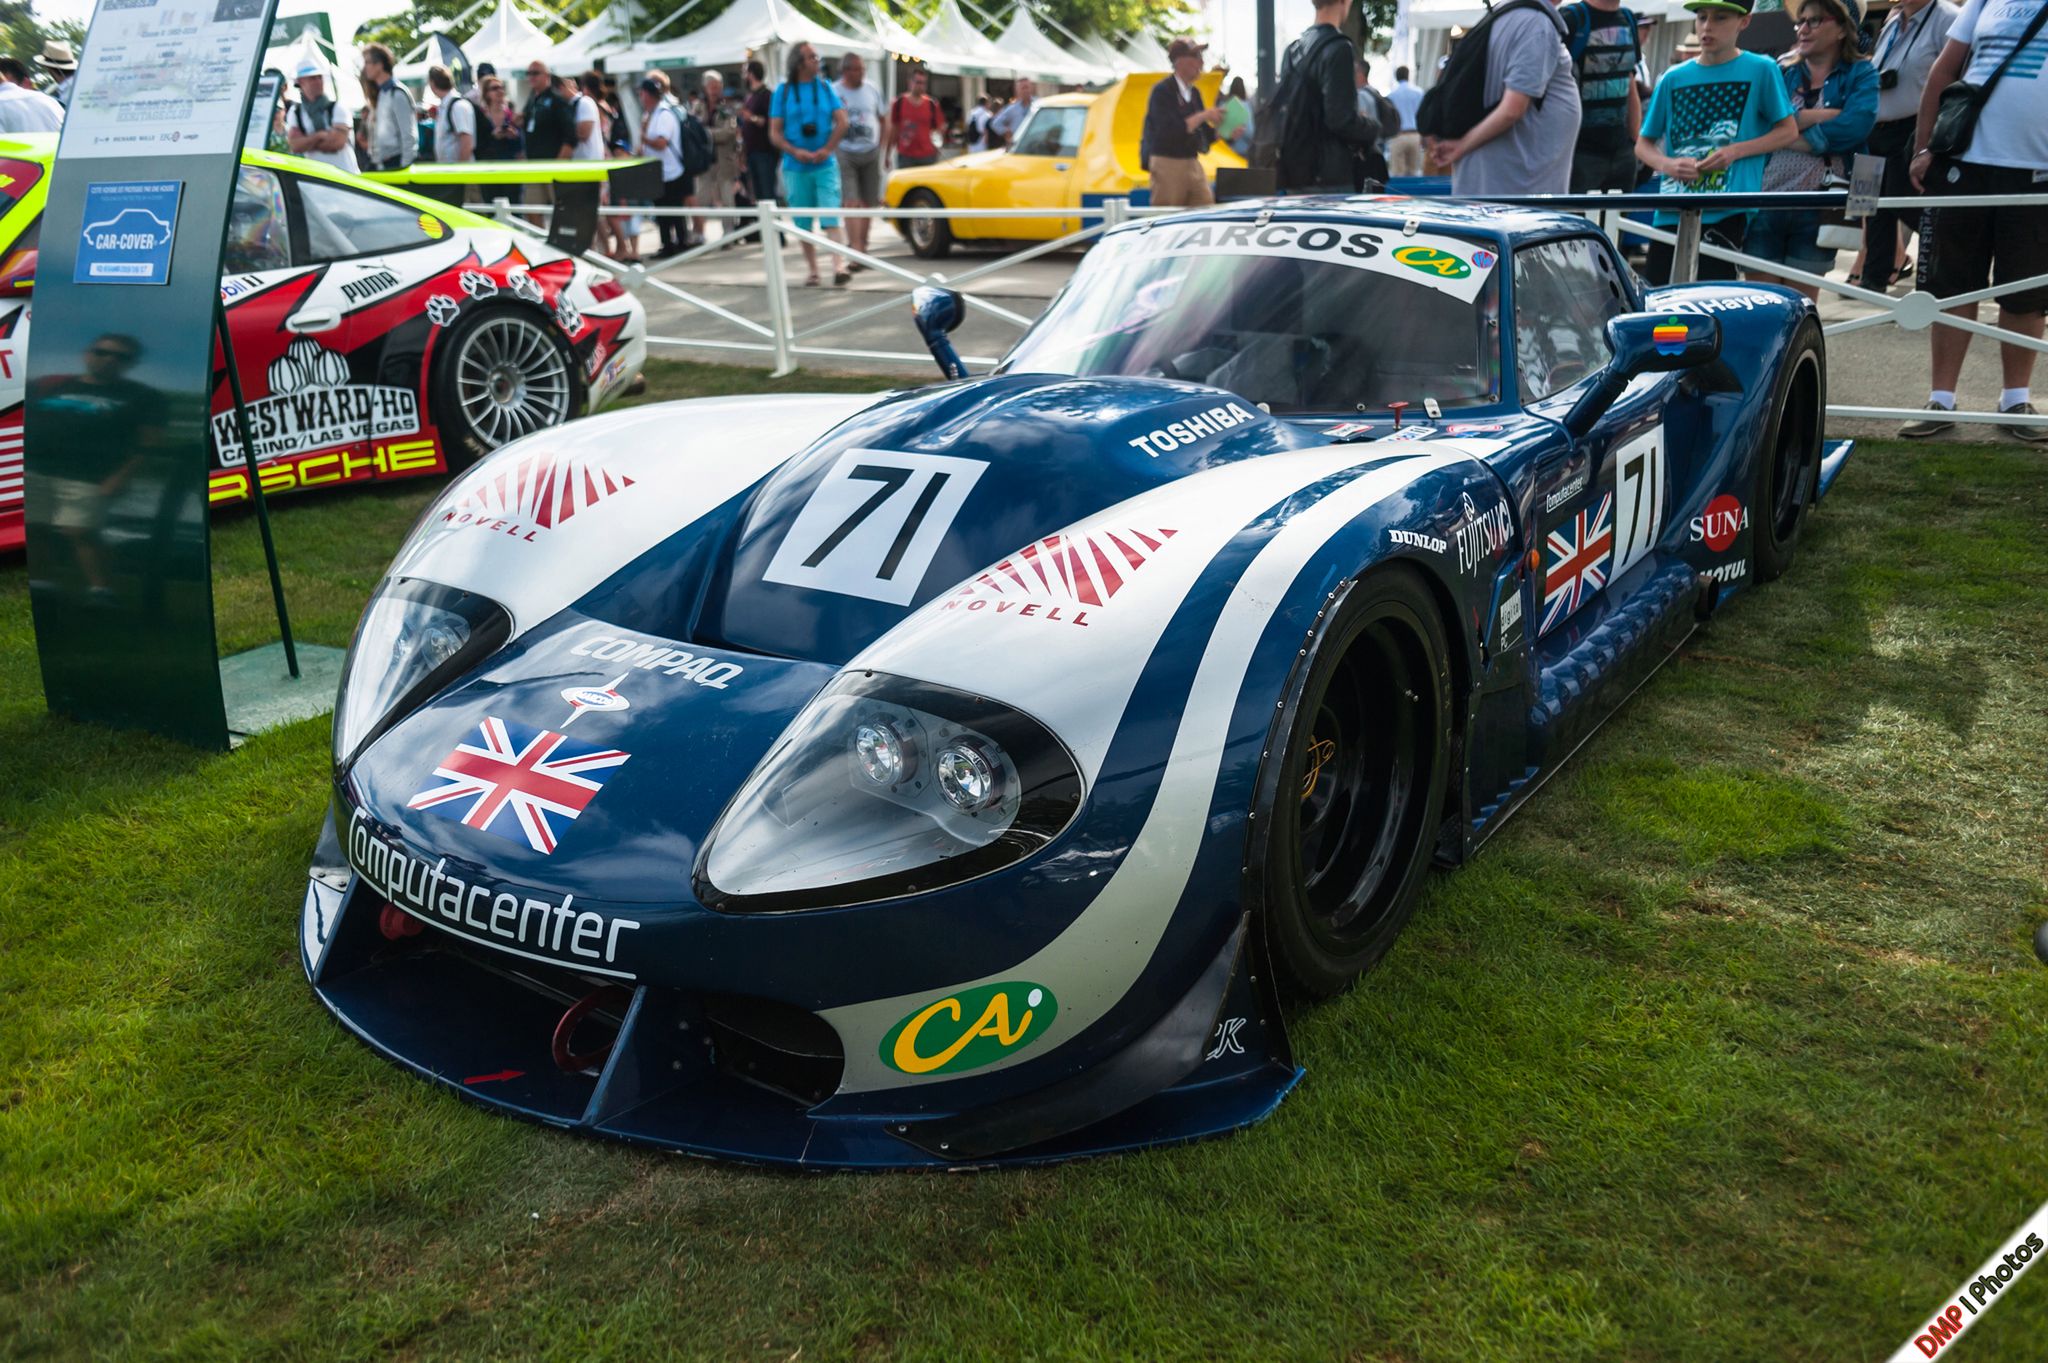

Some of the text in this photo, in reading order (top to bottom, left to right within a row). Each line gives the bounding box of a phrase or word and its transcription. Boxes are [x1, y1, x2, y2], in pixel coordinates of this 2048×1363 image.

[96, 233, 155, 249] CAR-COVER
[1136, 225, 1383, 258] MARCOS
[341, 271, 399, 303] PUMA
[1699, 293, 1782, 314] Hayes
[350, 418, 415, 437] VEGAS
[1128, 402, 1255, 458] TOSHIBA
[209, 440, 436, 502] RSCHE
[800, 464, 951, 581] 71
[1624, 446, 1657, 567] 71
[442, 512, 537, 542] NOVELL
[1389, 529, 1447, 554] DUNLOP
[941, 600, 1089, 627] NOVELL
[570, 636, 744, 690] COMPAQ
[349, 806, 641, 978] Computacenter
